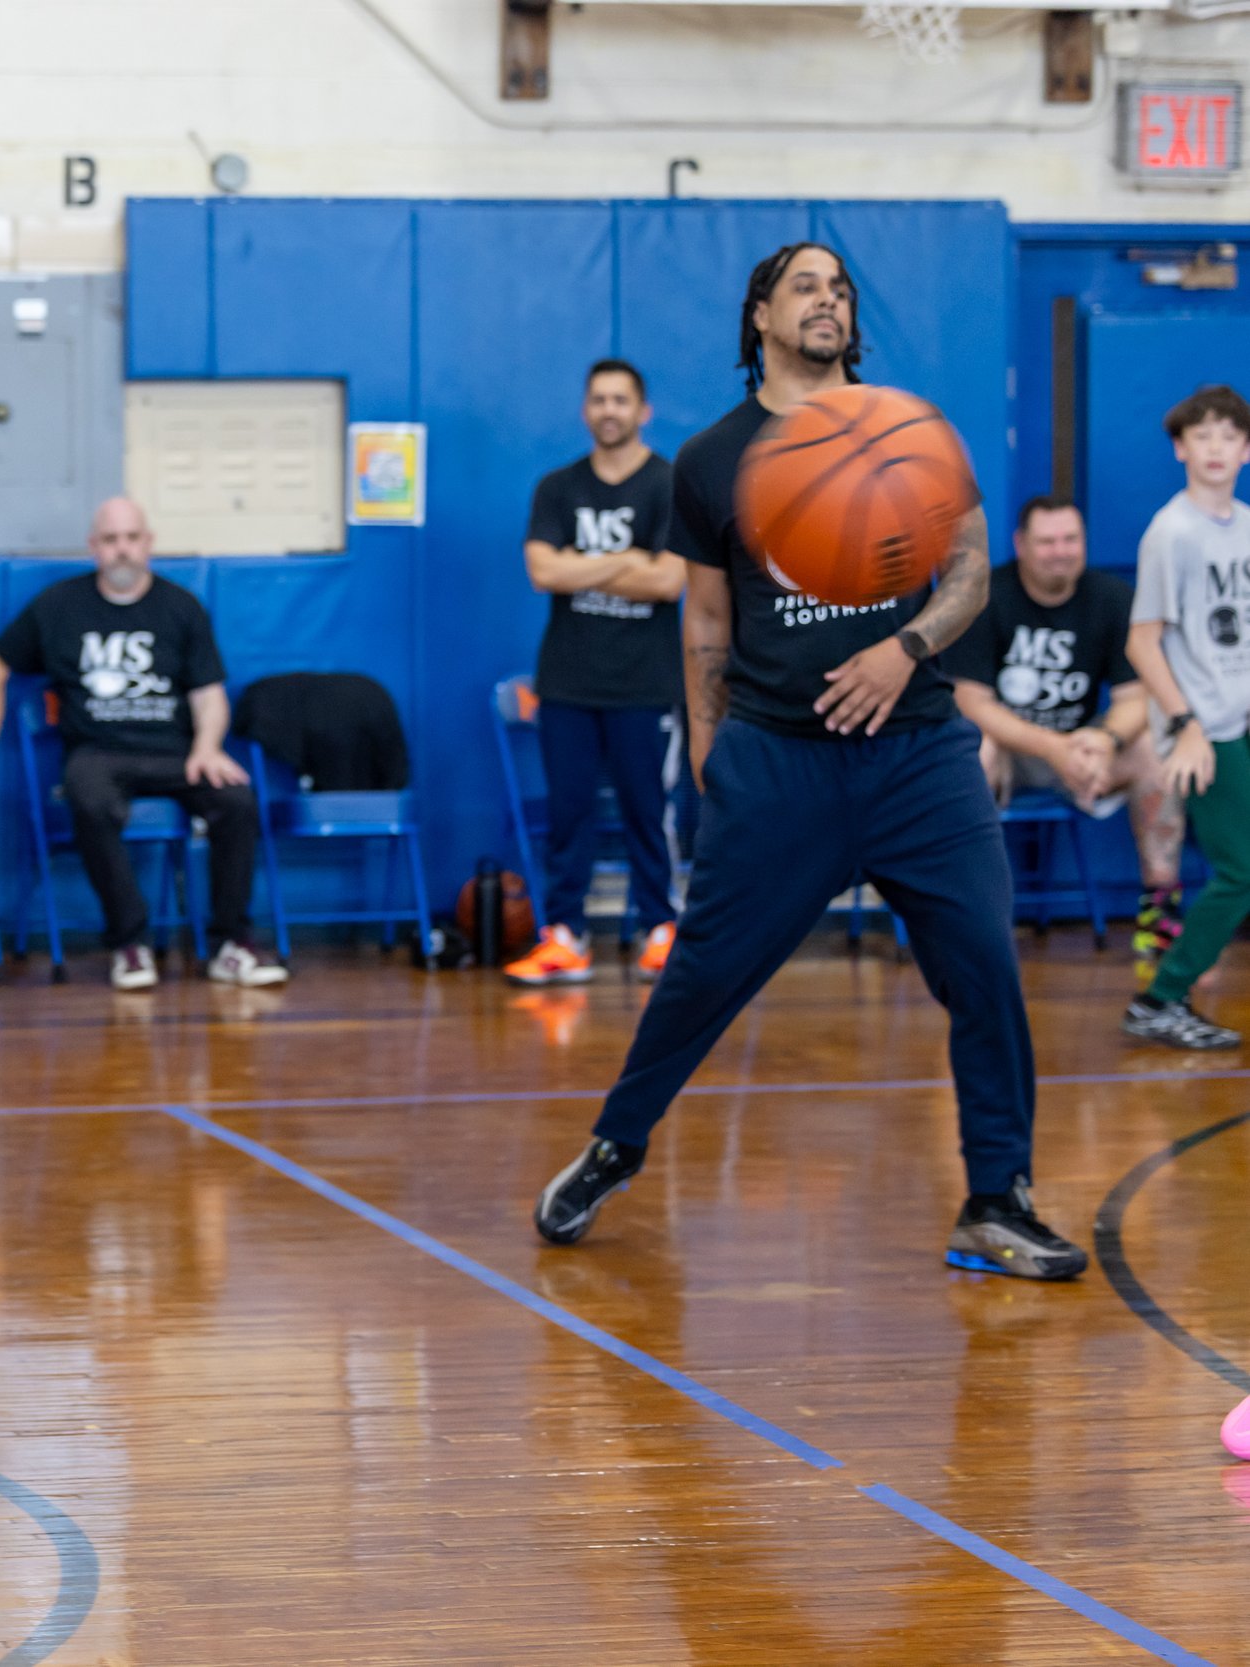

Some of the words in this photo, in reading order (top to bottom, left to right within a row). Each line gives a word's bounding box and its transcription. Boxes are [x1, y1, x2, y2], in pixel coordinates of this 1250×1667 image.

[1138, 95, 1232, 169] EXIT
[63, 156, 97, 206] B
[575, 506, 635, 554] MS
[774, 594, 830, 614] PRID
[79, 630, 156, 674] MS
[1004, 625, 1077, 671] MS
[1034, 670, 1091, 711] 50
